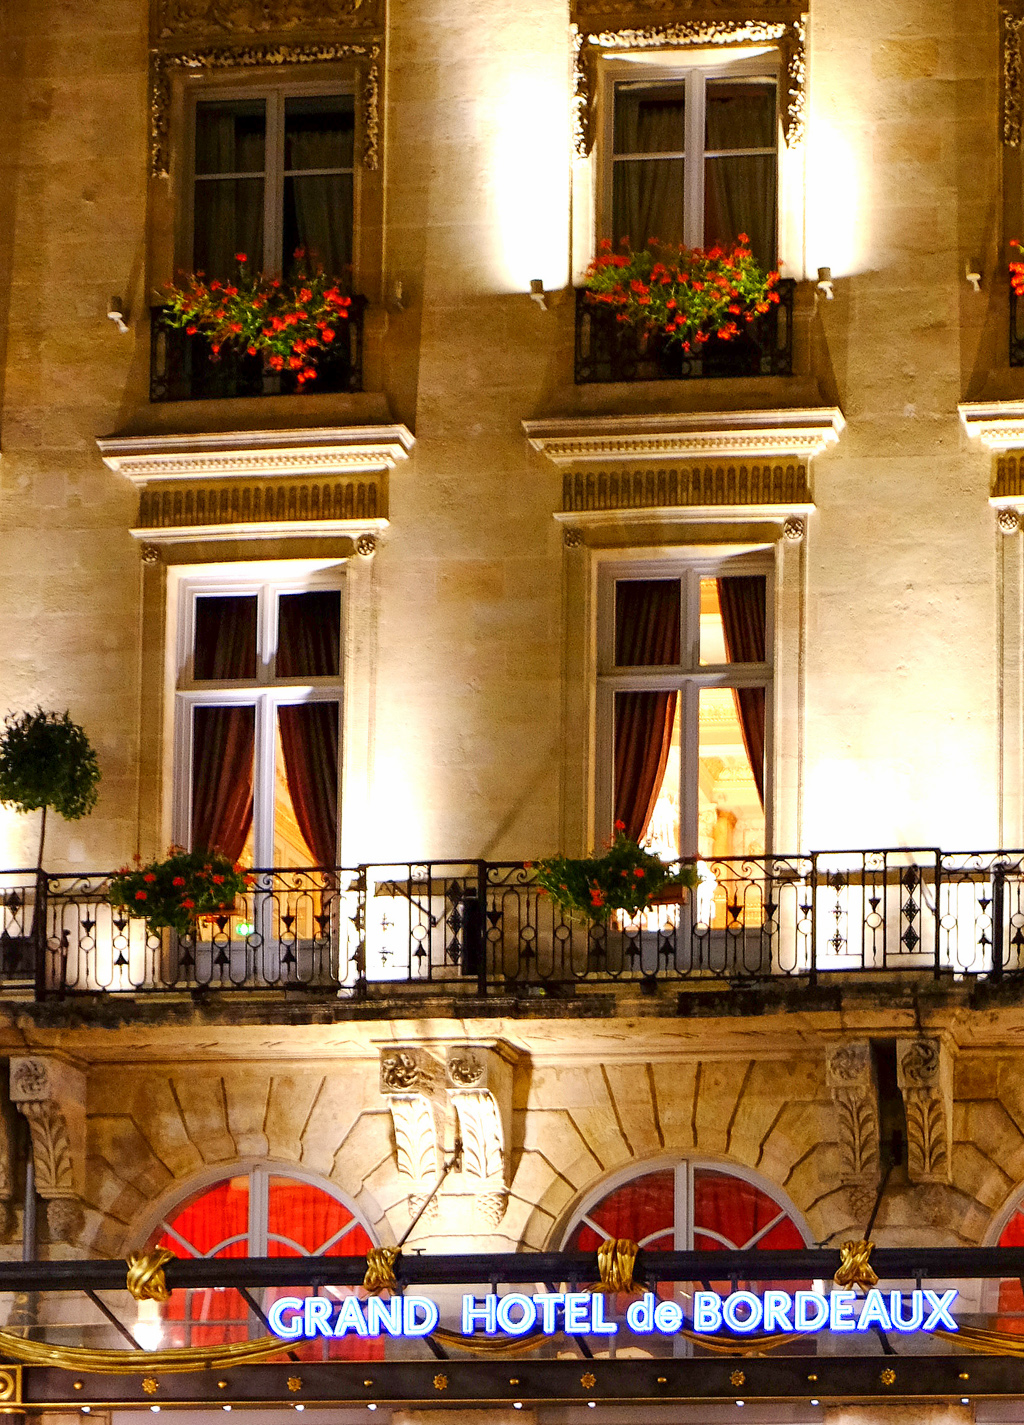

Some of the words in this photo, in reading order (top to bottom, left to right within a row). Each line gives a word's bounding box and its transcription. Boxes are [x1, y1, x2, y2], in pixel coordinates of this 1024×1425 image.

[267, 1295, 439, 1338] GRAND
[462, 1292, 618, 1335] HOTEL
[626, 1291, 684, 1333] de
[694, 1289, 959, 1334] BORDEAUX
